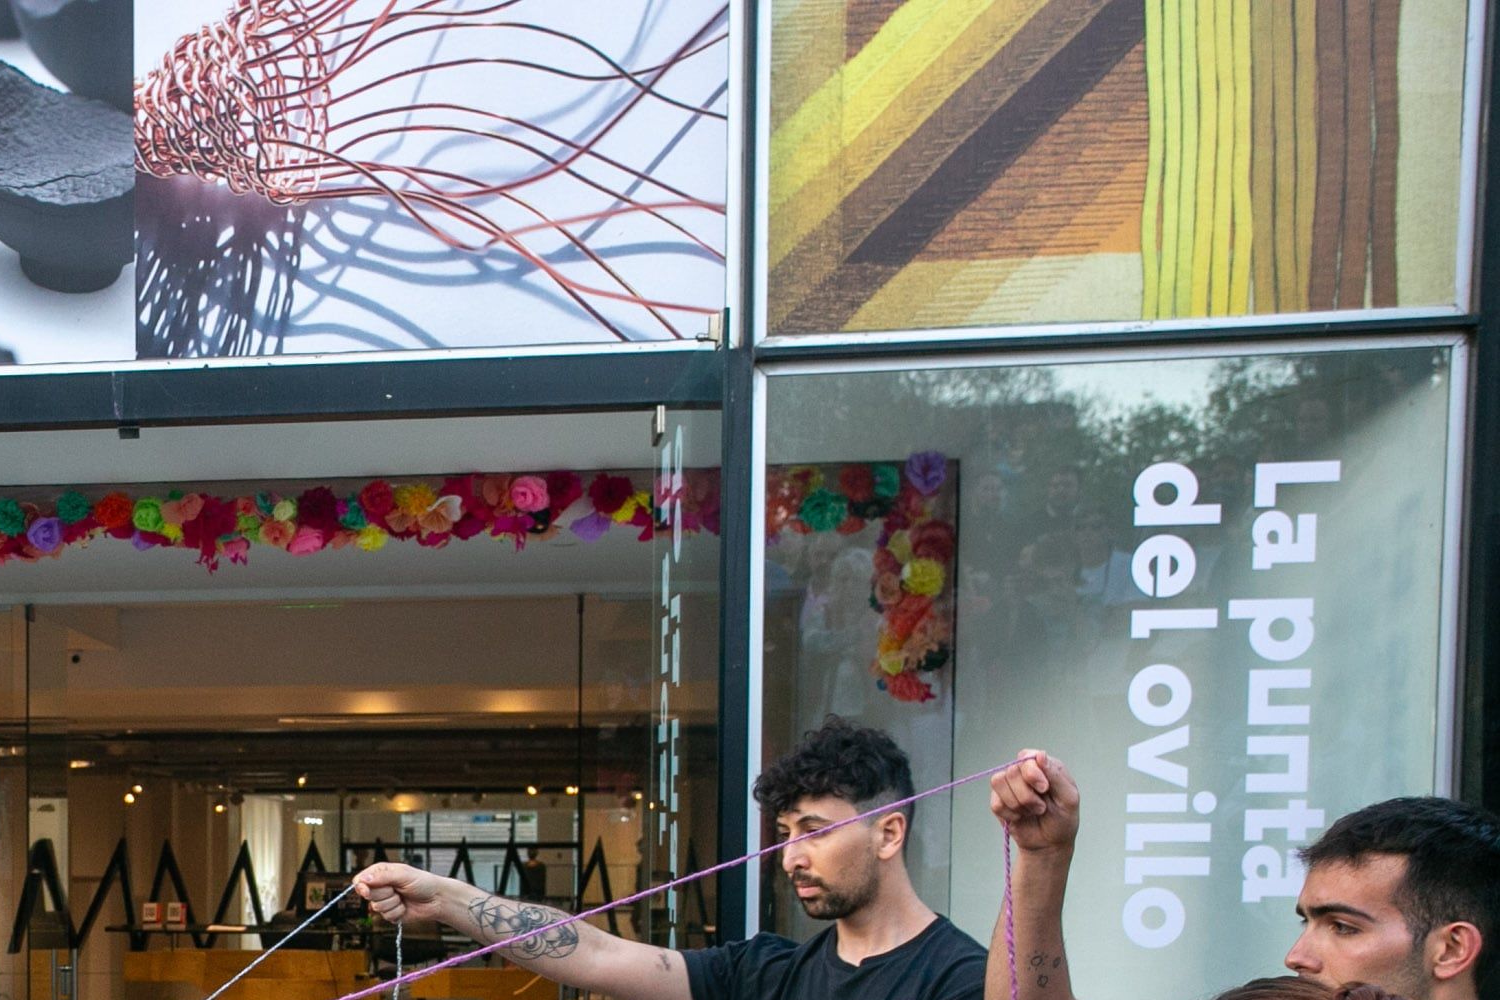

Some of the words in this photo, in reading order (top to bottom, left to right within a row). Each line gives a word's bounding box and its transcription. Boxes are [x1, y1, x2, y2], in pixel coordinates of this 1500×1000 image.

[1131, 462, 1222, 638] del
[1252, 460, 1341, 570] La
[1122, 664, 1218, 949] ovillo
[1228, 597, 1326, 903] punta
